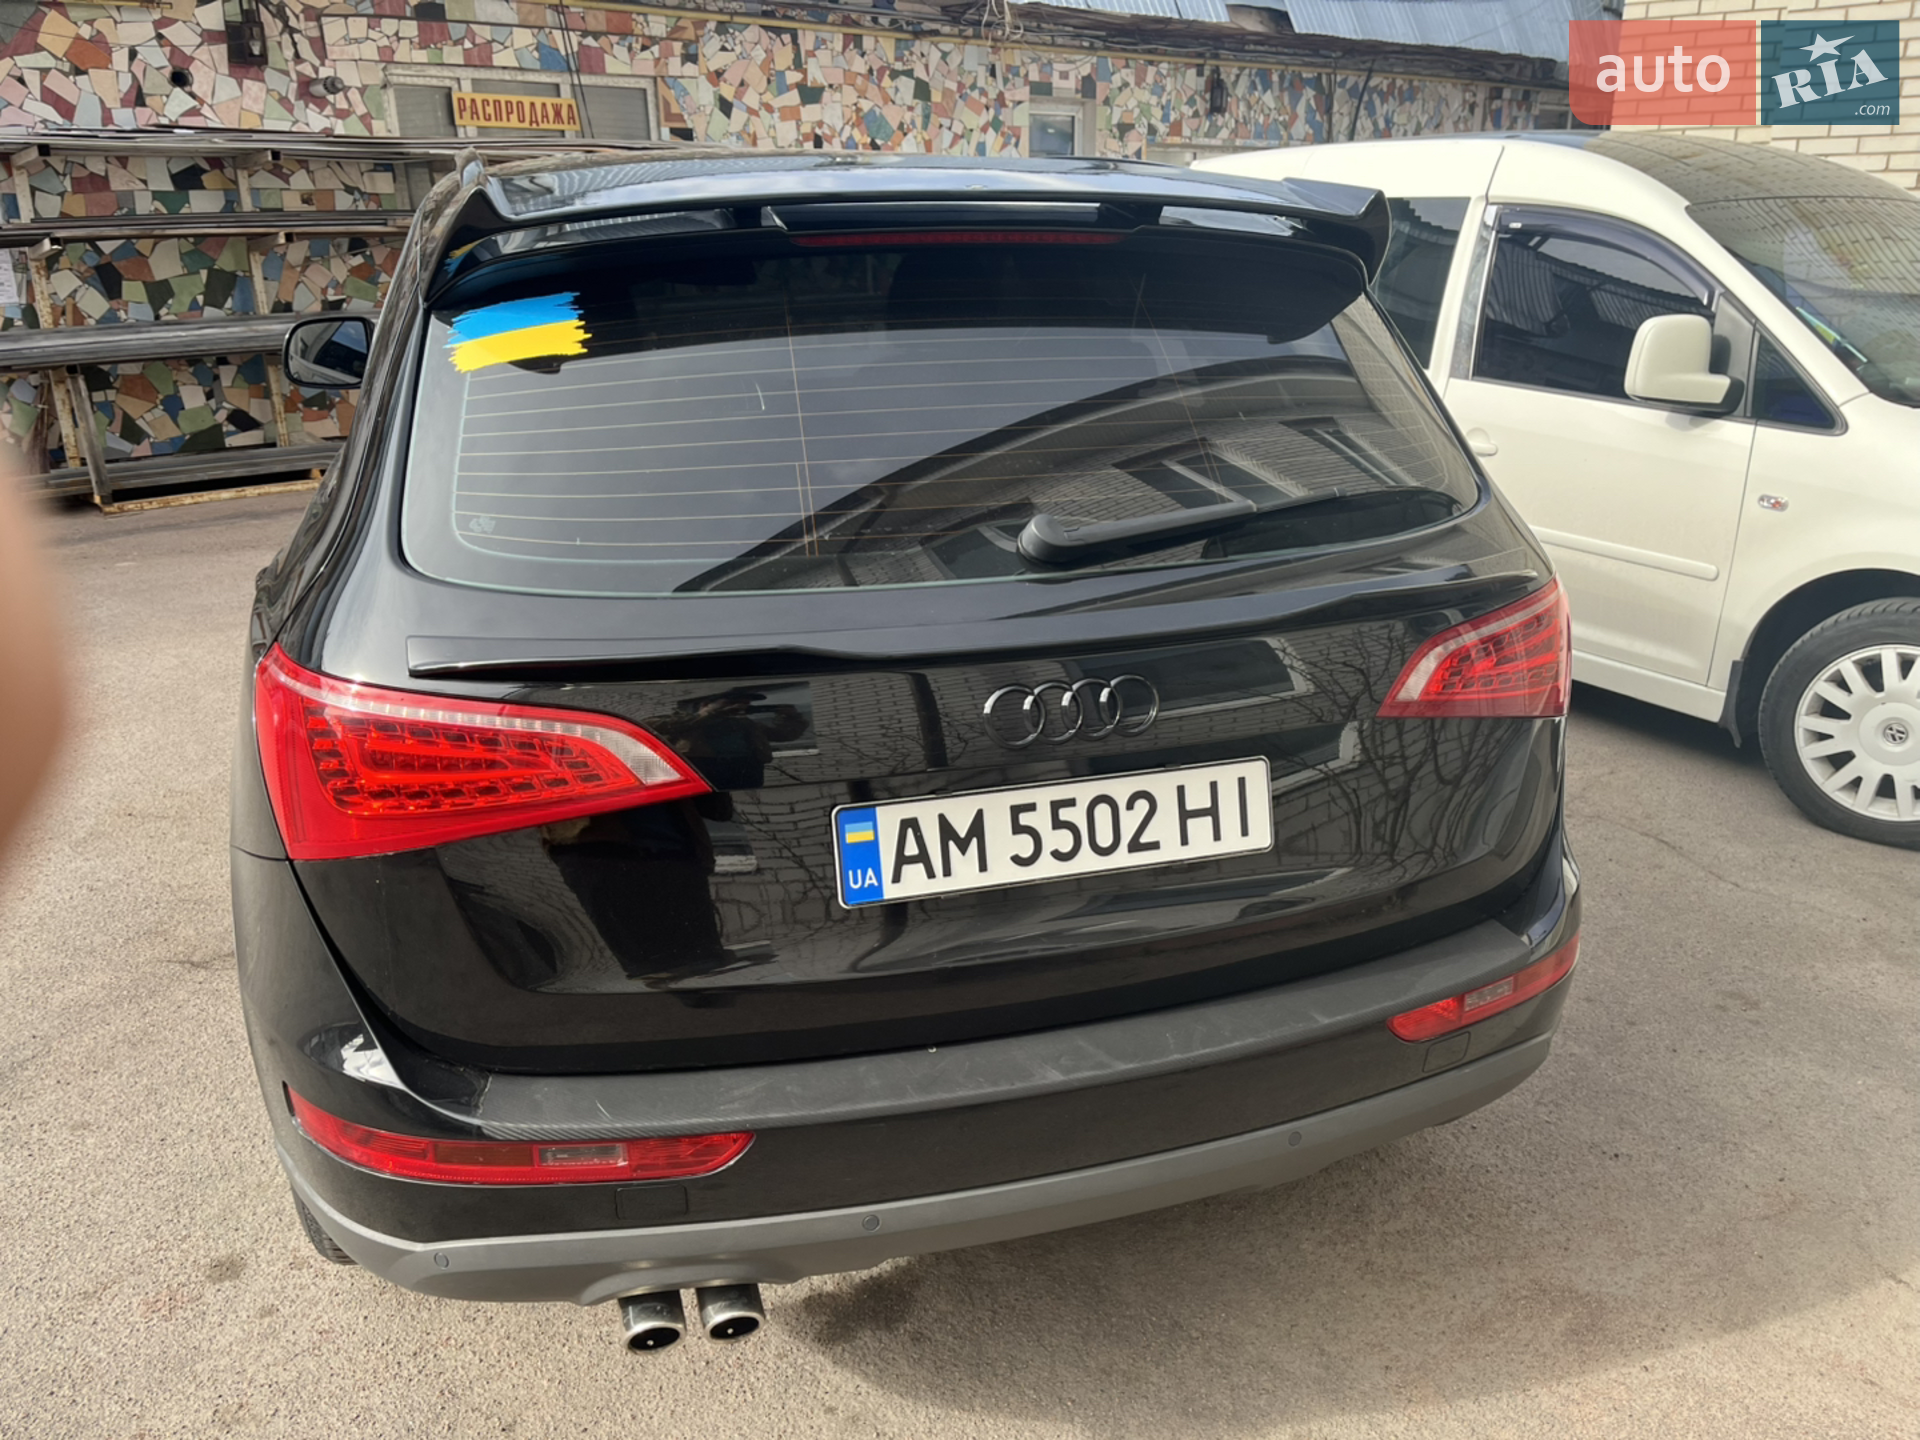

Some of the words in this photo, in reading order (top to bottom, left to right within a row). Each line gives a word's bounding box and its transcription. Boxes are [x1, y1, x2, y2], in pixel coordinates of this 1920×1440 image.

[457, 97, 576, 127] РАСПРОДАЖА
[891, 808, 989, 883] AM
[1009, 790, 1160, 867] 5502
[1177, 776, 1249, 846] HI
[848, 867, 879, 889] UA
